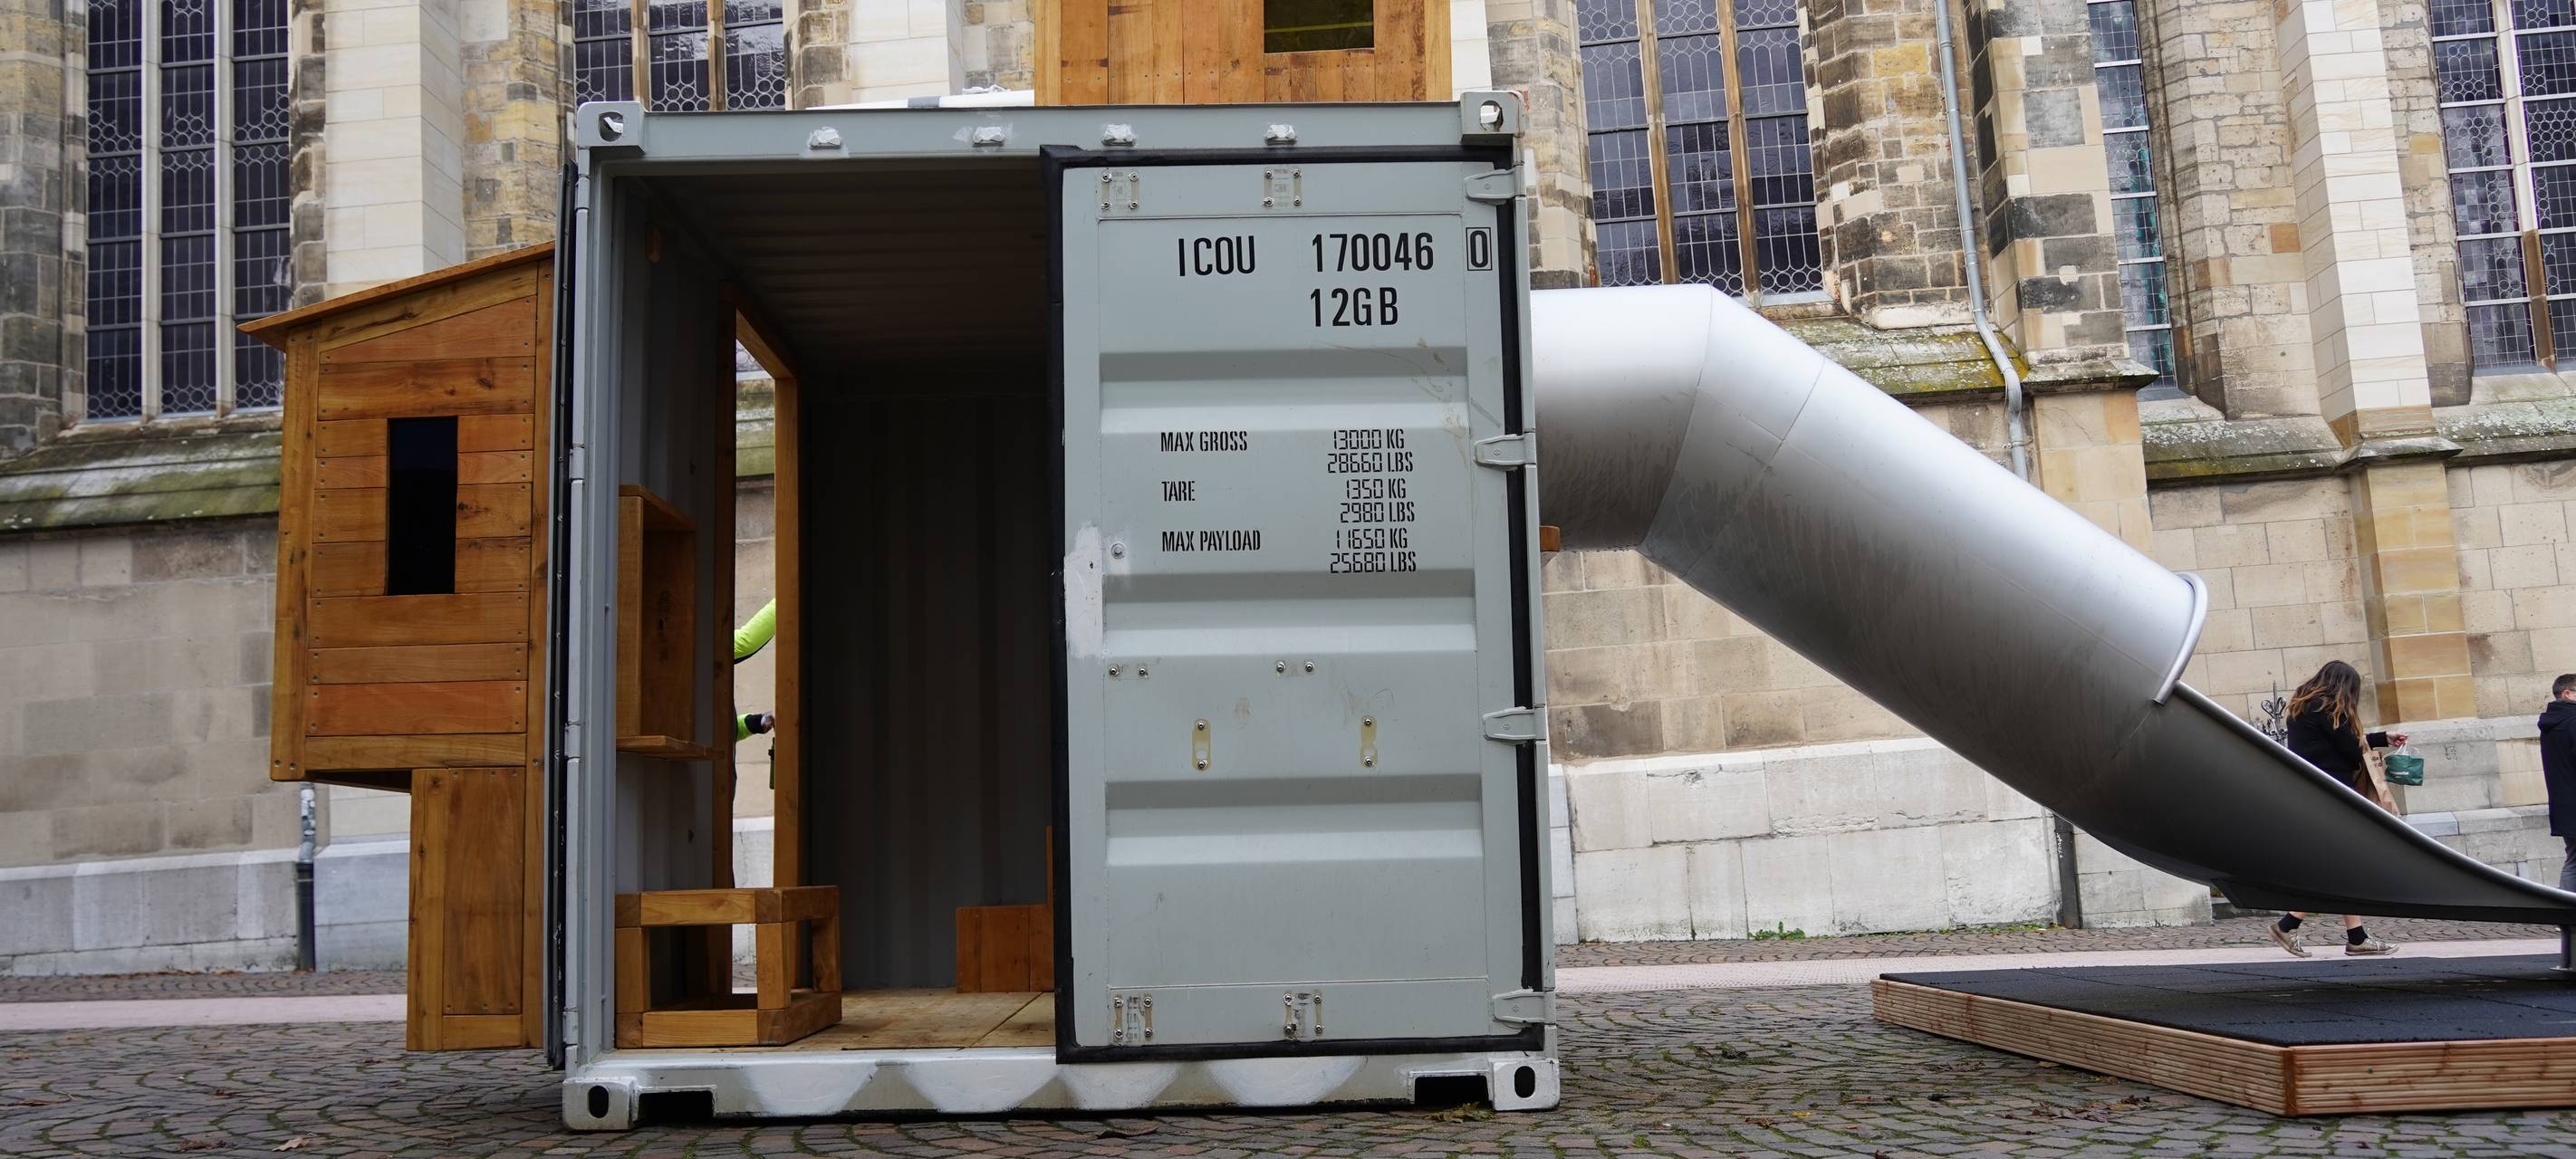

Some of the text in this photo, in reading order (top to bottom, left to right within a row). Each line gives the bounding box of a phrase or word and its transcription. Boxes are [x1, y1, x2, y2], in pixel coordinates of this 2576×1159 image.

[1177, 230, 1488, 277] ICOU 170046 0
[1310, 286, 1399, 328] 12GB
[1160, 428, 1405, 453] MAX GROSS 13000 KG
[1327, 451, 1414, 474] 28660 LBS
[1161, 477, 1407, 503] TARE 1350 KG
[1340, 501, 1416, 523] 2980 LBS
[1161, 527, 1408, 552] MAX PAYLOAD 11650 KG
[1330, 551, 1417, 574] 25680 LBS
